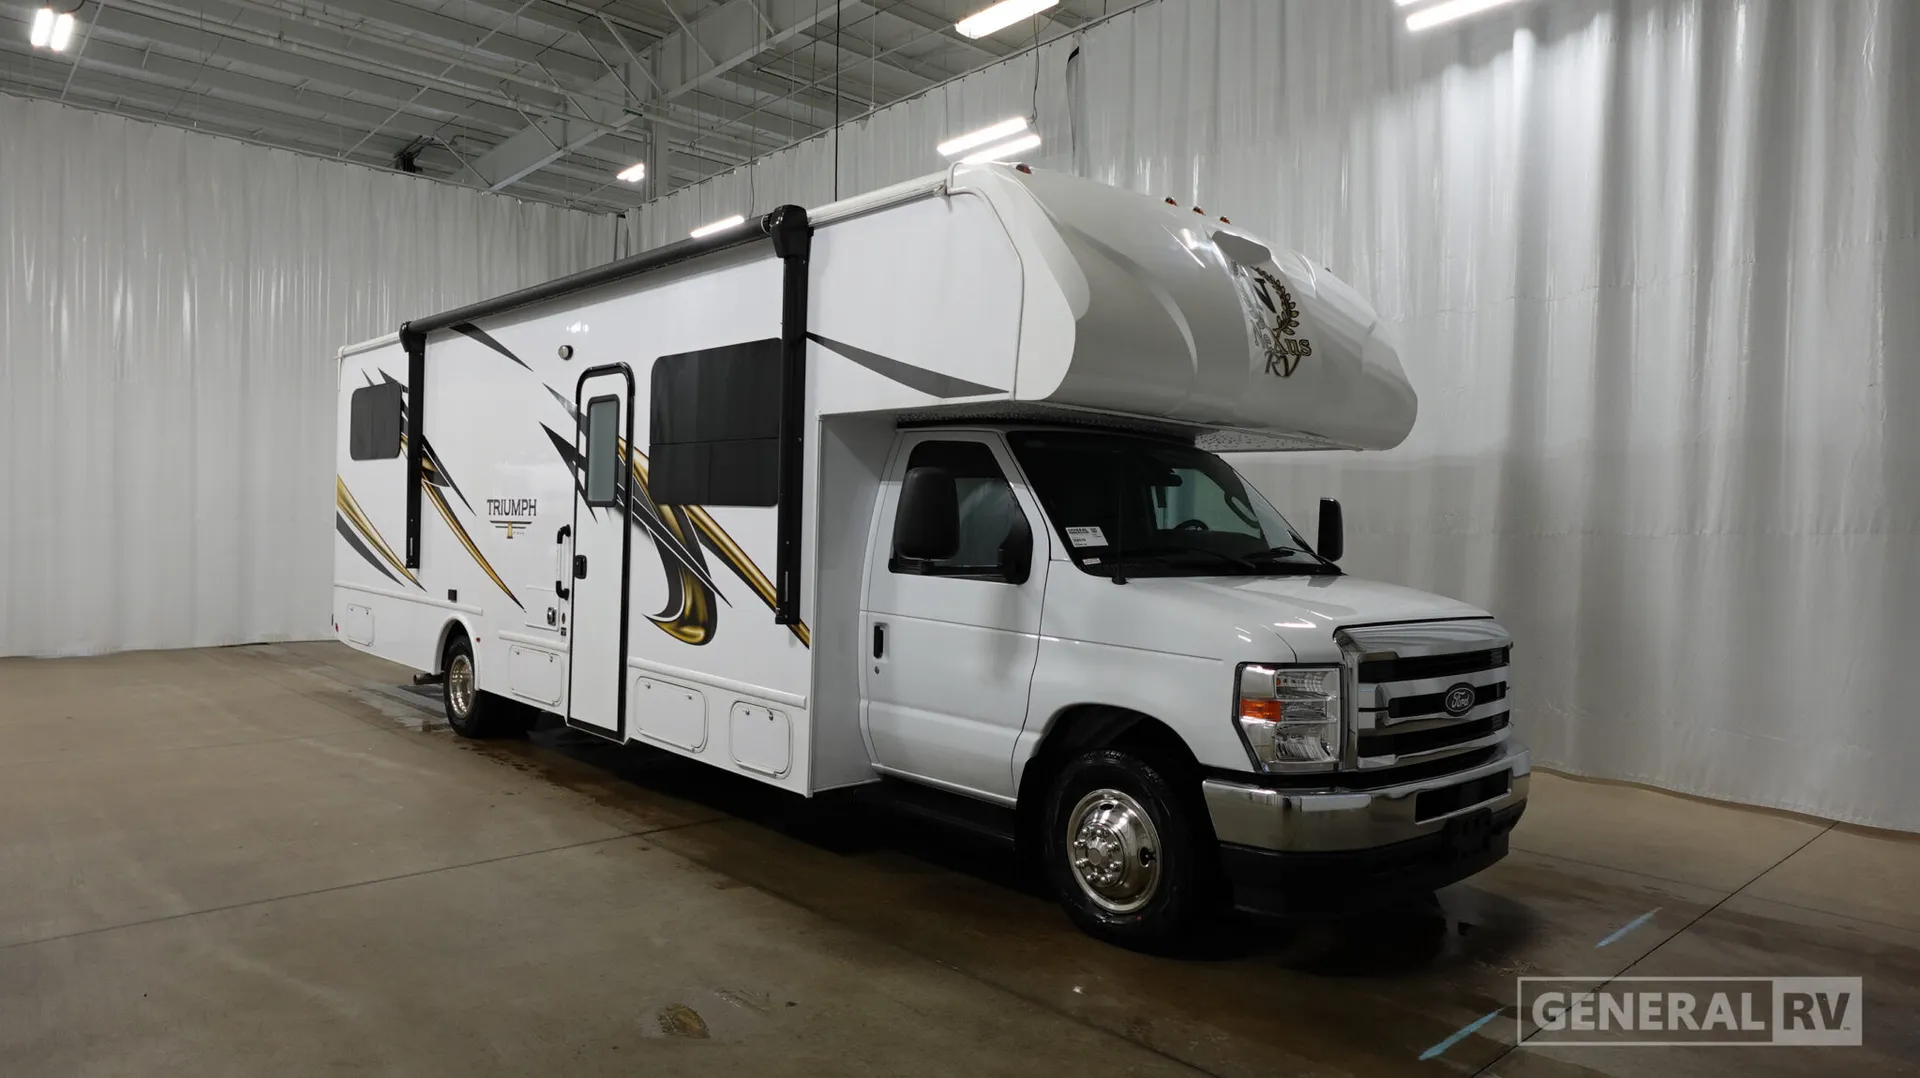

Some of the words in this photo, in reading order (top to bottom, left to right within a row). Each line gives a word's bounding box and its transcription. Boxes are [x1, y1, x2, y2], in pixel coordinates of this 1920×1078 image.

[1264, 350, 1302, 378] RV
[486, 499, 537, 516] TRIUMPH
[1451, 691, 1470, 709] Ford
